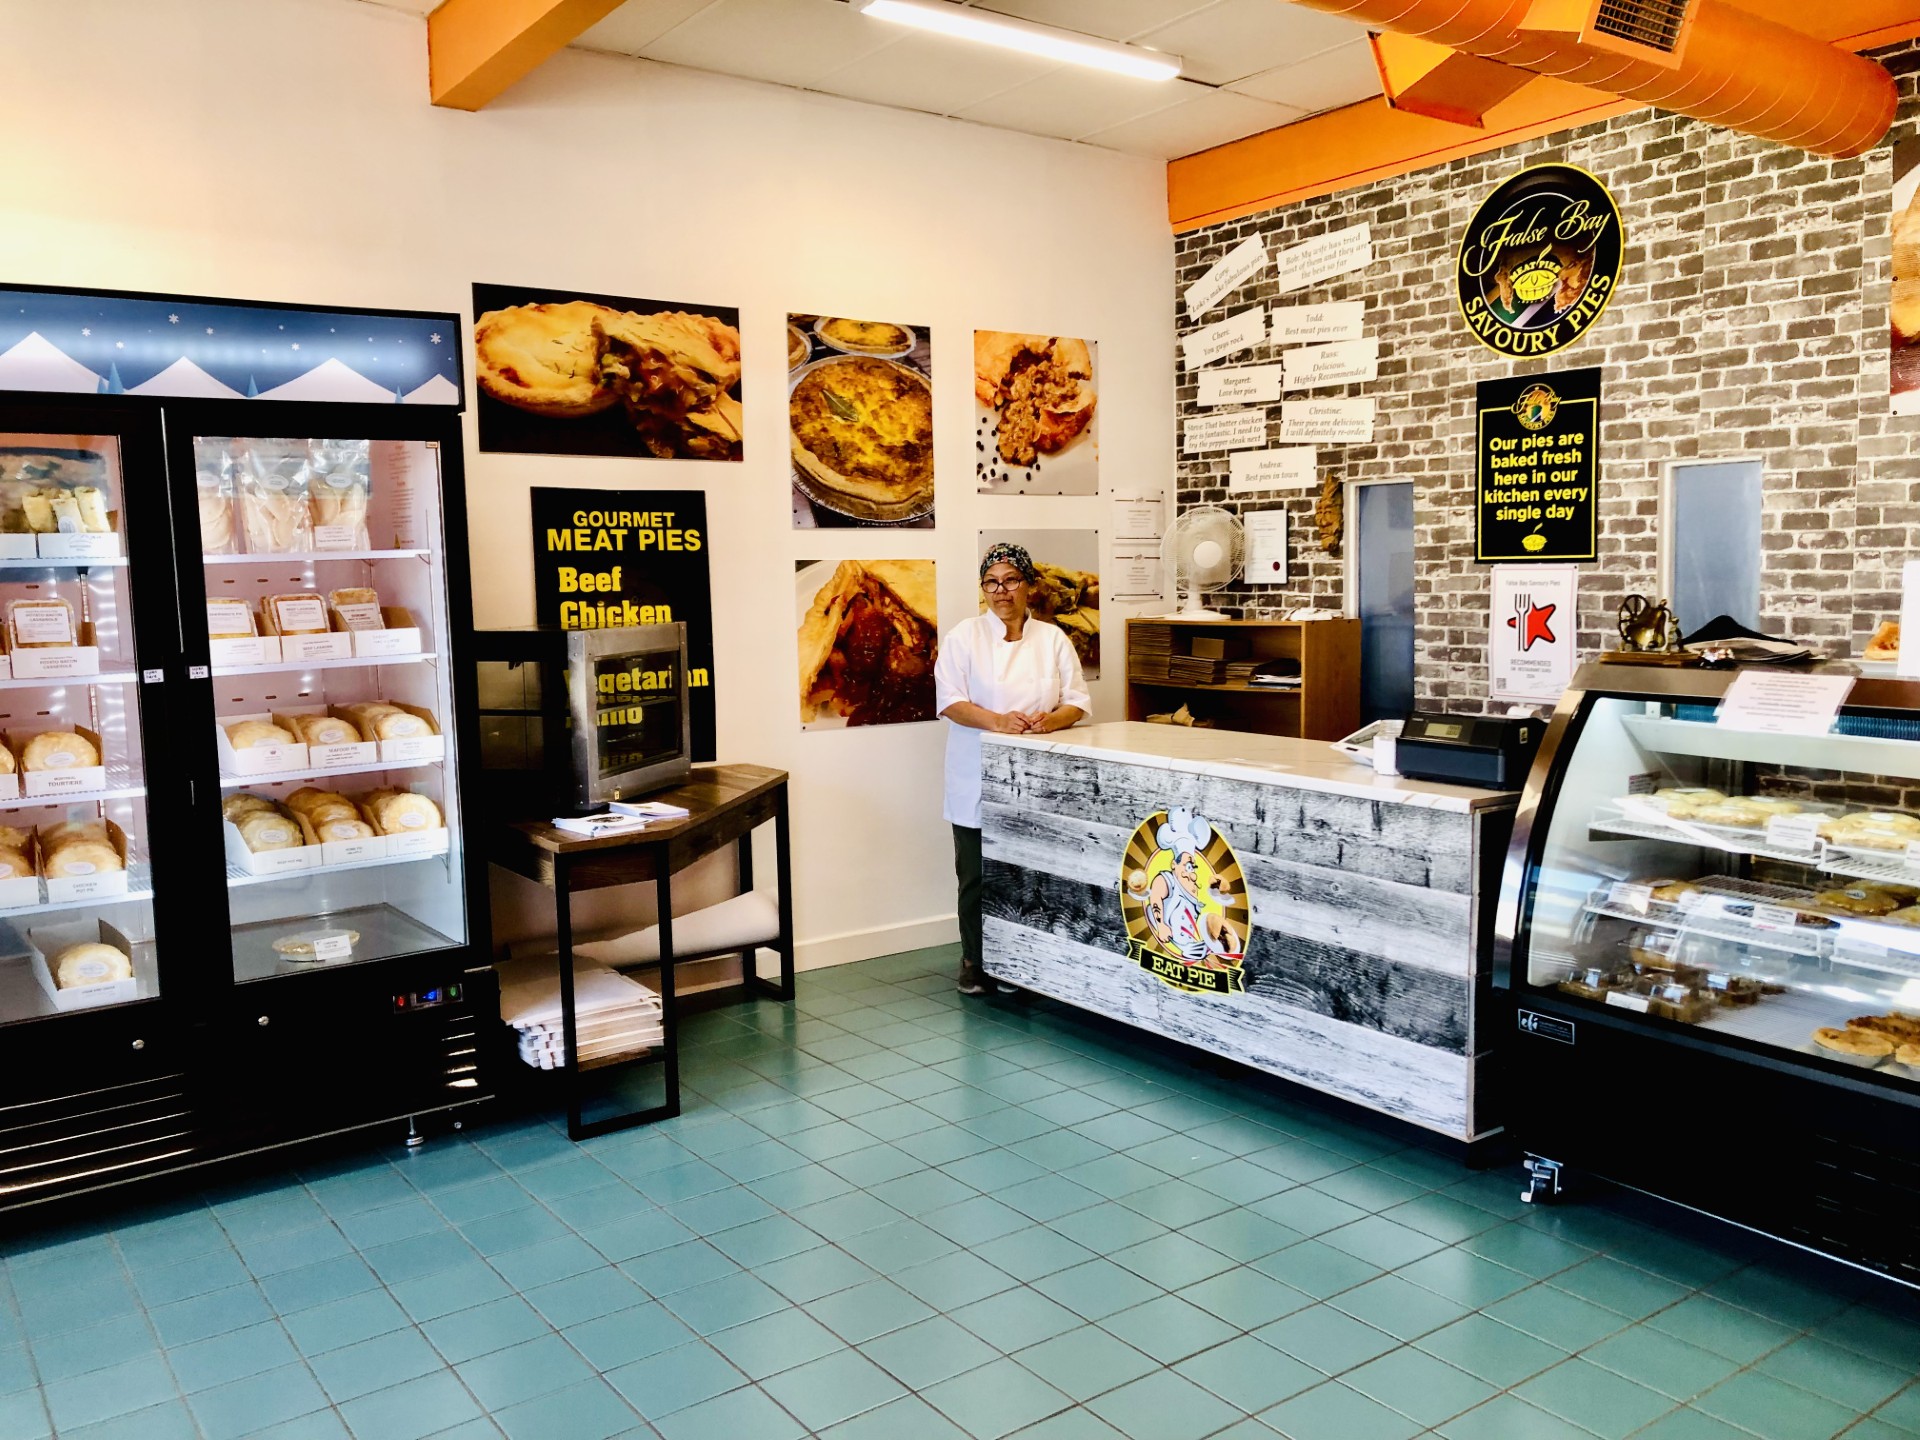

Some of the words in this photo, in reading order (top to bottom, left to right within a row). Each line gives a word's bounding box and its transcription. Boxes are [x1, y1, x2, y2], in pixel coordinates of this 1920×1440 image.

[1328, 241, 1342, 250] has
[1343, 232, 1361, 245] tried
[1462, 207, 1548, 277] False
[1554, 200, 1612, 253] Bay
[1306, 257, 1323, 268] them
[1324, 250, 1337, 261] and
[1339, 247, 1354, 257] they
[1355, 242, 1368, 252] are
[1301, 270, 1311, 279] the
[1312, 266, 1326, 275] best
[1336, 259, 1348, 271] far
[1509, 261, 1536, 282] MEAT
[1538, 260, 1562, 274] PIES
[1305, 312, 1324, 323] Todd:
[1465, 295, 1561, 353] SAVOURY
[1565, 274, 1611, 333] PIES
[1285, 327, 1299, 336] Best
[1300, 326, 1316, 335] meat
[1316, 325, 1331, 336] pies
[1332, 325, 1348, 333] ever
[1203, 347, 1215, 356] You
[1215, 341, 1230, 353] guys
[1230, 333, 1244, 345] rock
[1320, 351, 1339, 360] Russ:
[1223, 376, 1252, 387] Margaret:
[1293, 374, 1317, 385] Highly
[1317, 366, 1367, 381] Recommended
[1218, 388, 1232, 397] Love
[1233, 387, 1243, 396] her
[1243, 387, 1257, 398] pies
[1308, 406, 1343, 415] Christine:
[1204, 421, 1218, 430] That
[1219, 420, 1238, 428] butter
[1238, 416, 1263, 426] chicken
[1288, 418, 1305, 427] Their
[1305, 419, 1319, 429] pies
[1188, 433, 1198, 442] pie
[1237, 426, 1252, 434] need
[1253, 425, 1261, 433] to
[1289, 428, 1303, 437] will
[1304, 427, 1336, 438] definitely
[1188, 442, 1198, 451] try
[1198, 440, 1208, 448] the
[1208, 439, 1228, 449] pepper
[1229, 436, 1246, 445] steak
[1246, 434, 1261, 442] next
[1489, 436, 1518, 451] Our
[1521, 433, 1554, 452] pies
[1558, 432, 1585, 447] are
[1258, 461, 1283, 470] Andrea:
[1490, 451, 1538, 469] baked
[1542, 448, 1582, 465] fresh
[1245, 473, 1258, 482] Best
[1258, 472, 1272, 483] pies
[1272, 472, 1280, 480] in
[1281, 471, 1299, 479] town
[1494, 471, 1528, 486] here
[1531, 469, 1547, 484] in
[1550, 469, 1579, 483] our
[1484, 488, 1540, 504] kitchen
[1543, 486, 1589, 503] every
[572, 510, 676, 528] GOURMET
[1495, 504, 1542, 523] single
[1545, 503, 1576, 521] day
[547, 528, 629, 551] MEAT
[638, 528, 702, 551] PIES
[557, 565, 622, 593] Beef
[559, 599, 674, 630] Chicken
[1510, 658, 1552, 667] RECOMMENDED
[1151, 954, 1187, 981] EAT
[1186, 967, 1217, 988] PIE
